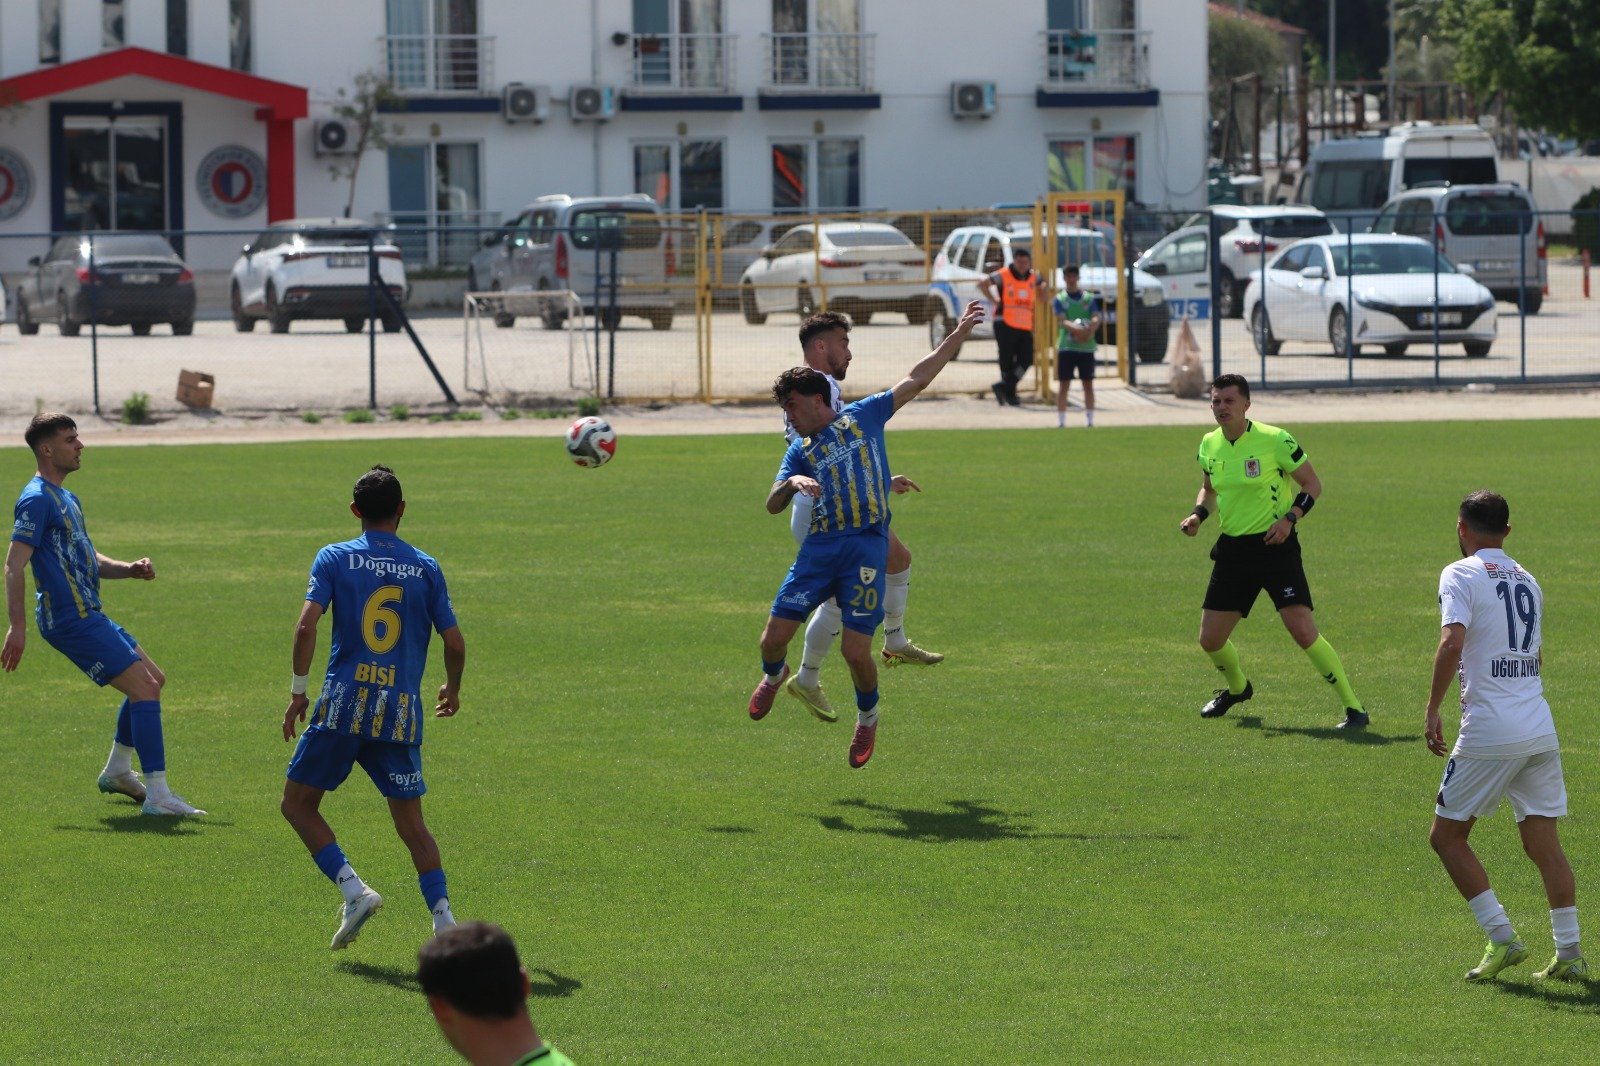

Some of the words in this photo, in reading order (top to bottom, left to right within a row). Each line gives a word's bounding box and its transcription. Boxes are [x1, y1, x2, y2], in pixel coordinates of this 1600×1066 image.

[849, 584, 878, 611] 20
[361, 585, 404, 655] 6
[1496, 580, 1537, 653] 19
[354, 661, 397, 689] BİŞİ
[1491, 656, 1519, 678] UĞUR
